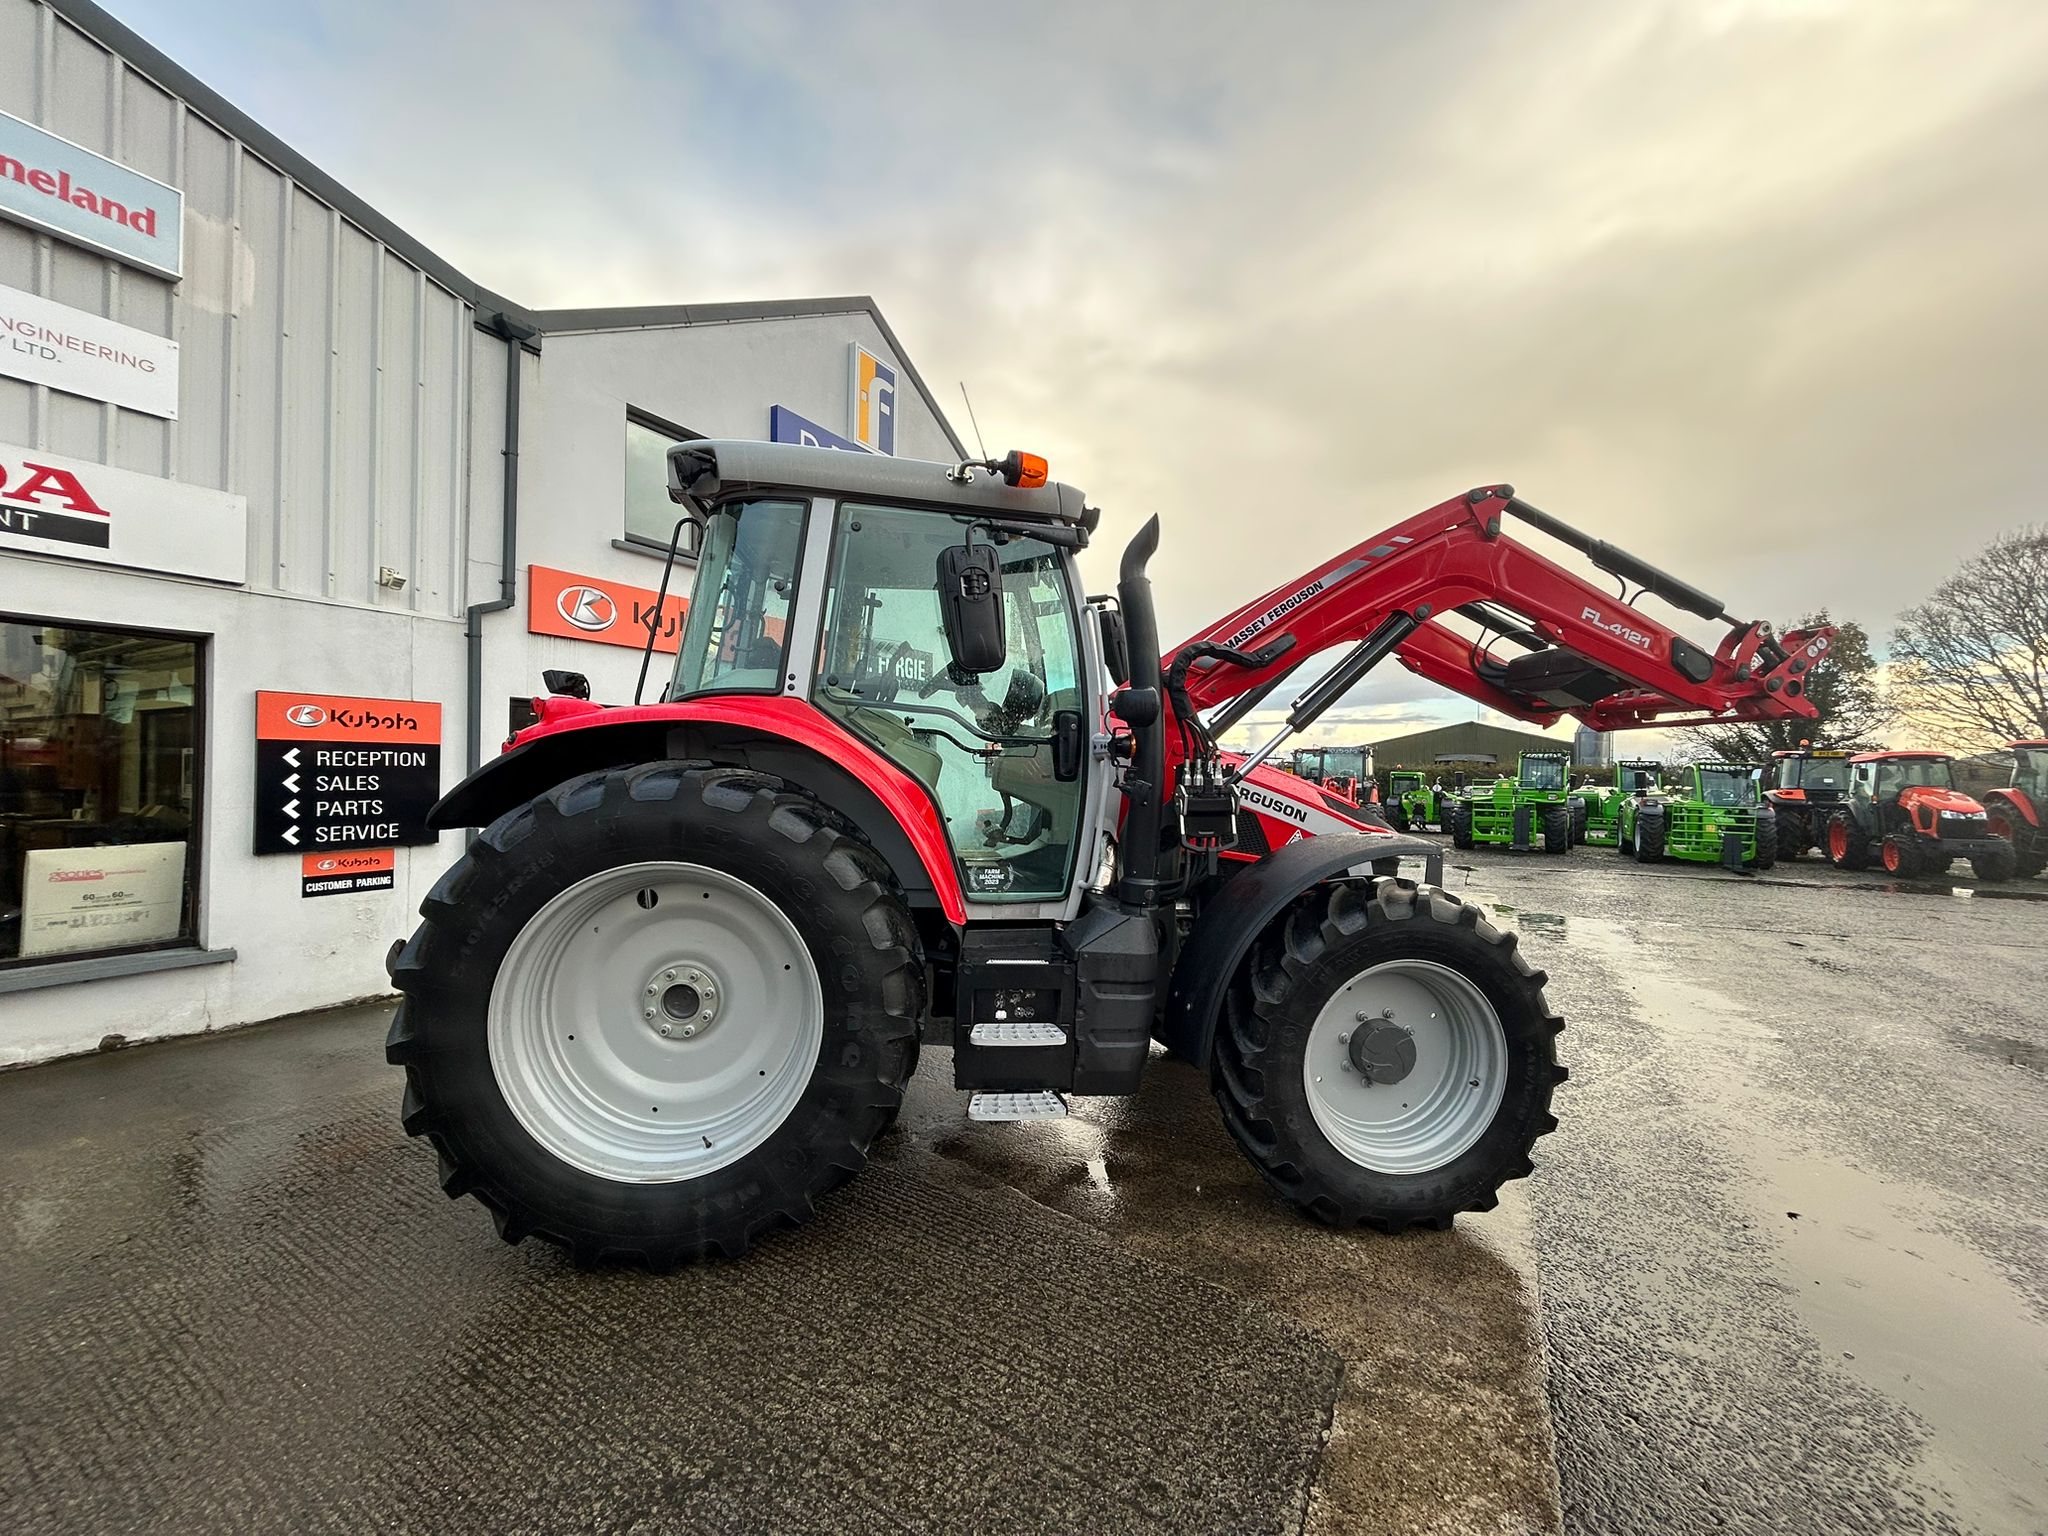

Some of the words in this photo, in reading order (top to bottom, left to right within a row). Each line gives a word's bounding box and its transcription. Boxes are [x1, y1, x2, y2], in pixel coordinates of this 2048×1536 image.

[12, 338, 63, 363] LTD.
[1267, 580, 1324, 622] FERGUSON
[330, 709, 418, 730] Kubota
[316, 750, 426, 767] RECEPTION
[315, 775, 380, 792] SALES
[316, 799, 383, 817] PARTS
[1236, 785, 1308, 823] RGUSON
[315, 823, 400, 843] SERVICE
[338, 857, 380, 867] Kubota
[305, 879, 353, 893] CUSTOMER
[356, 875, 391, 888] PARKING
